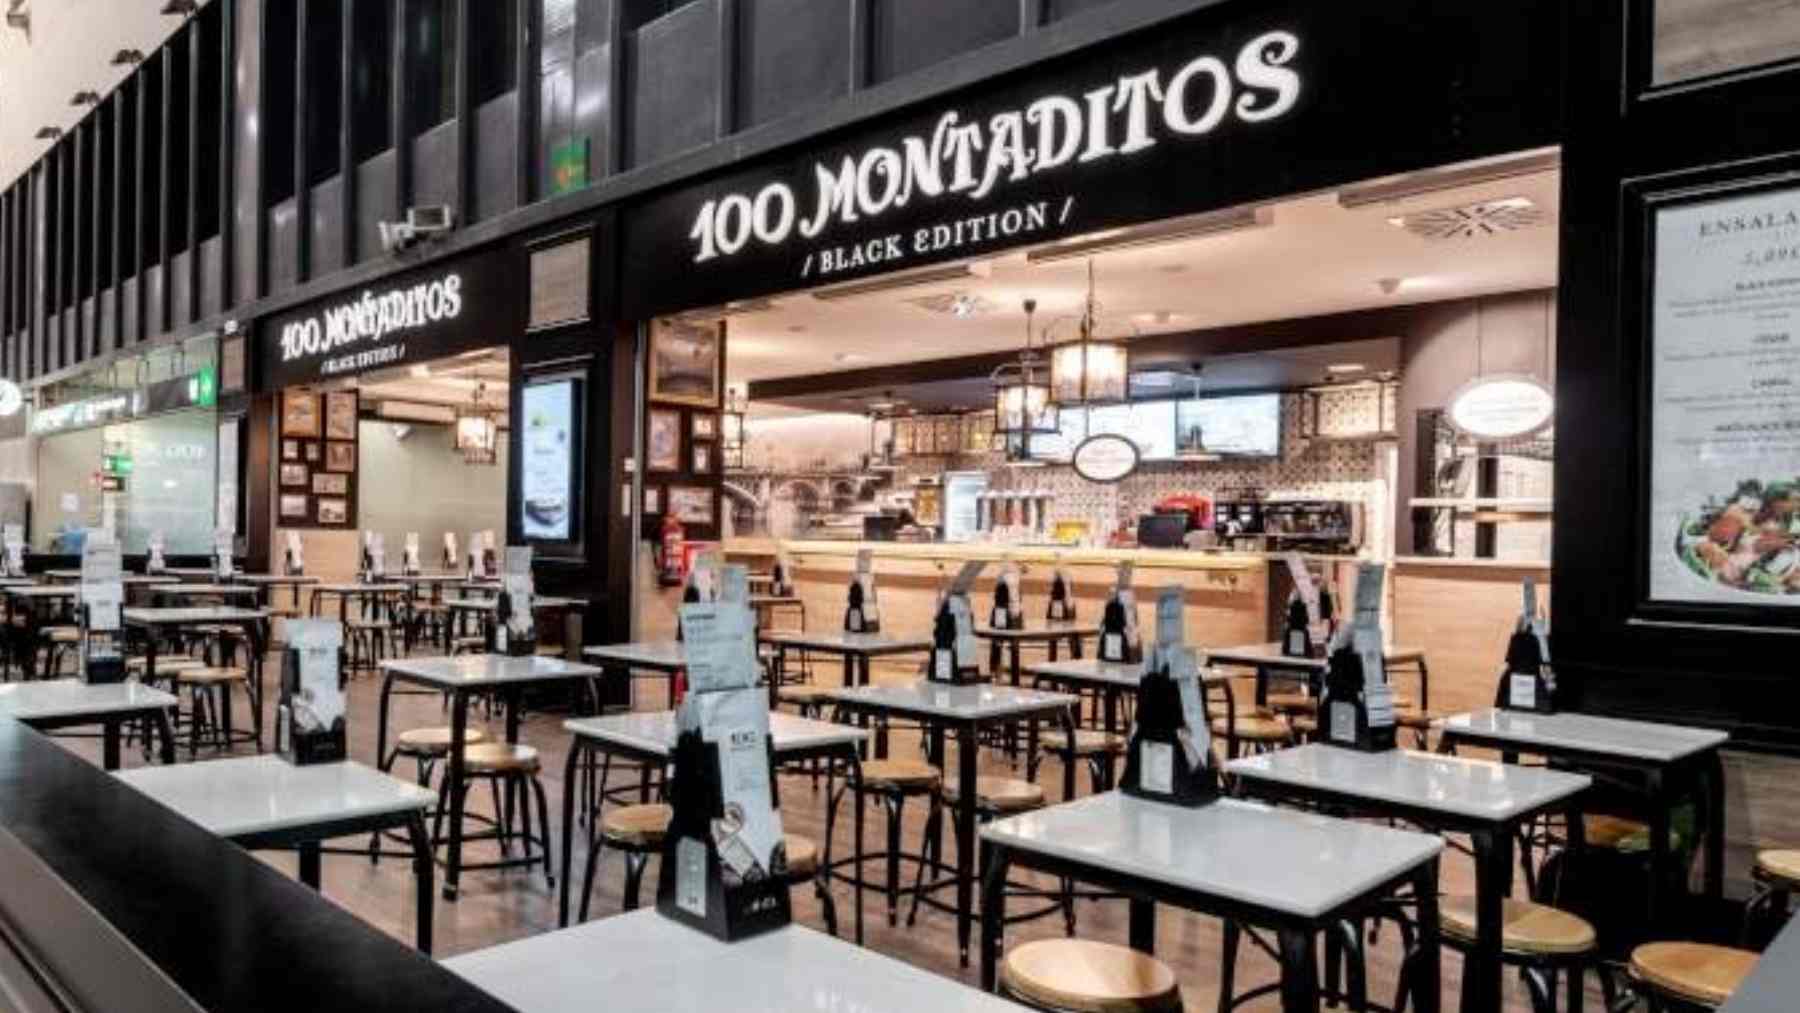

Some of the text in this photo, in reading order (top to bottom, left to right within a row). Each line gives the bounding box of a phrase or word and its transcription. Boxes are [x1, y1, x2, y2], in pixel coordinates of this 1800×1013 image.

[690, 30, 1302, 264] 100 MONTADITOS
[820, 234, 903, 275] BLACK
[913, 205, 1047, 251] EDITION
[280, 274, 462, 361] 100 MONTADITOS
